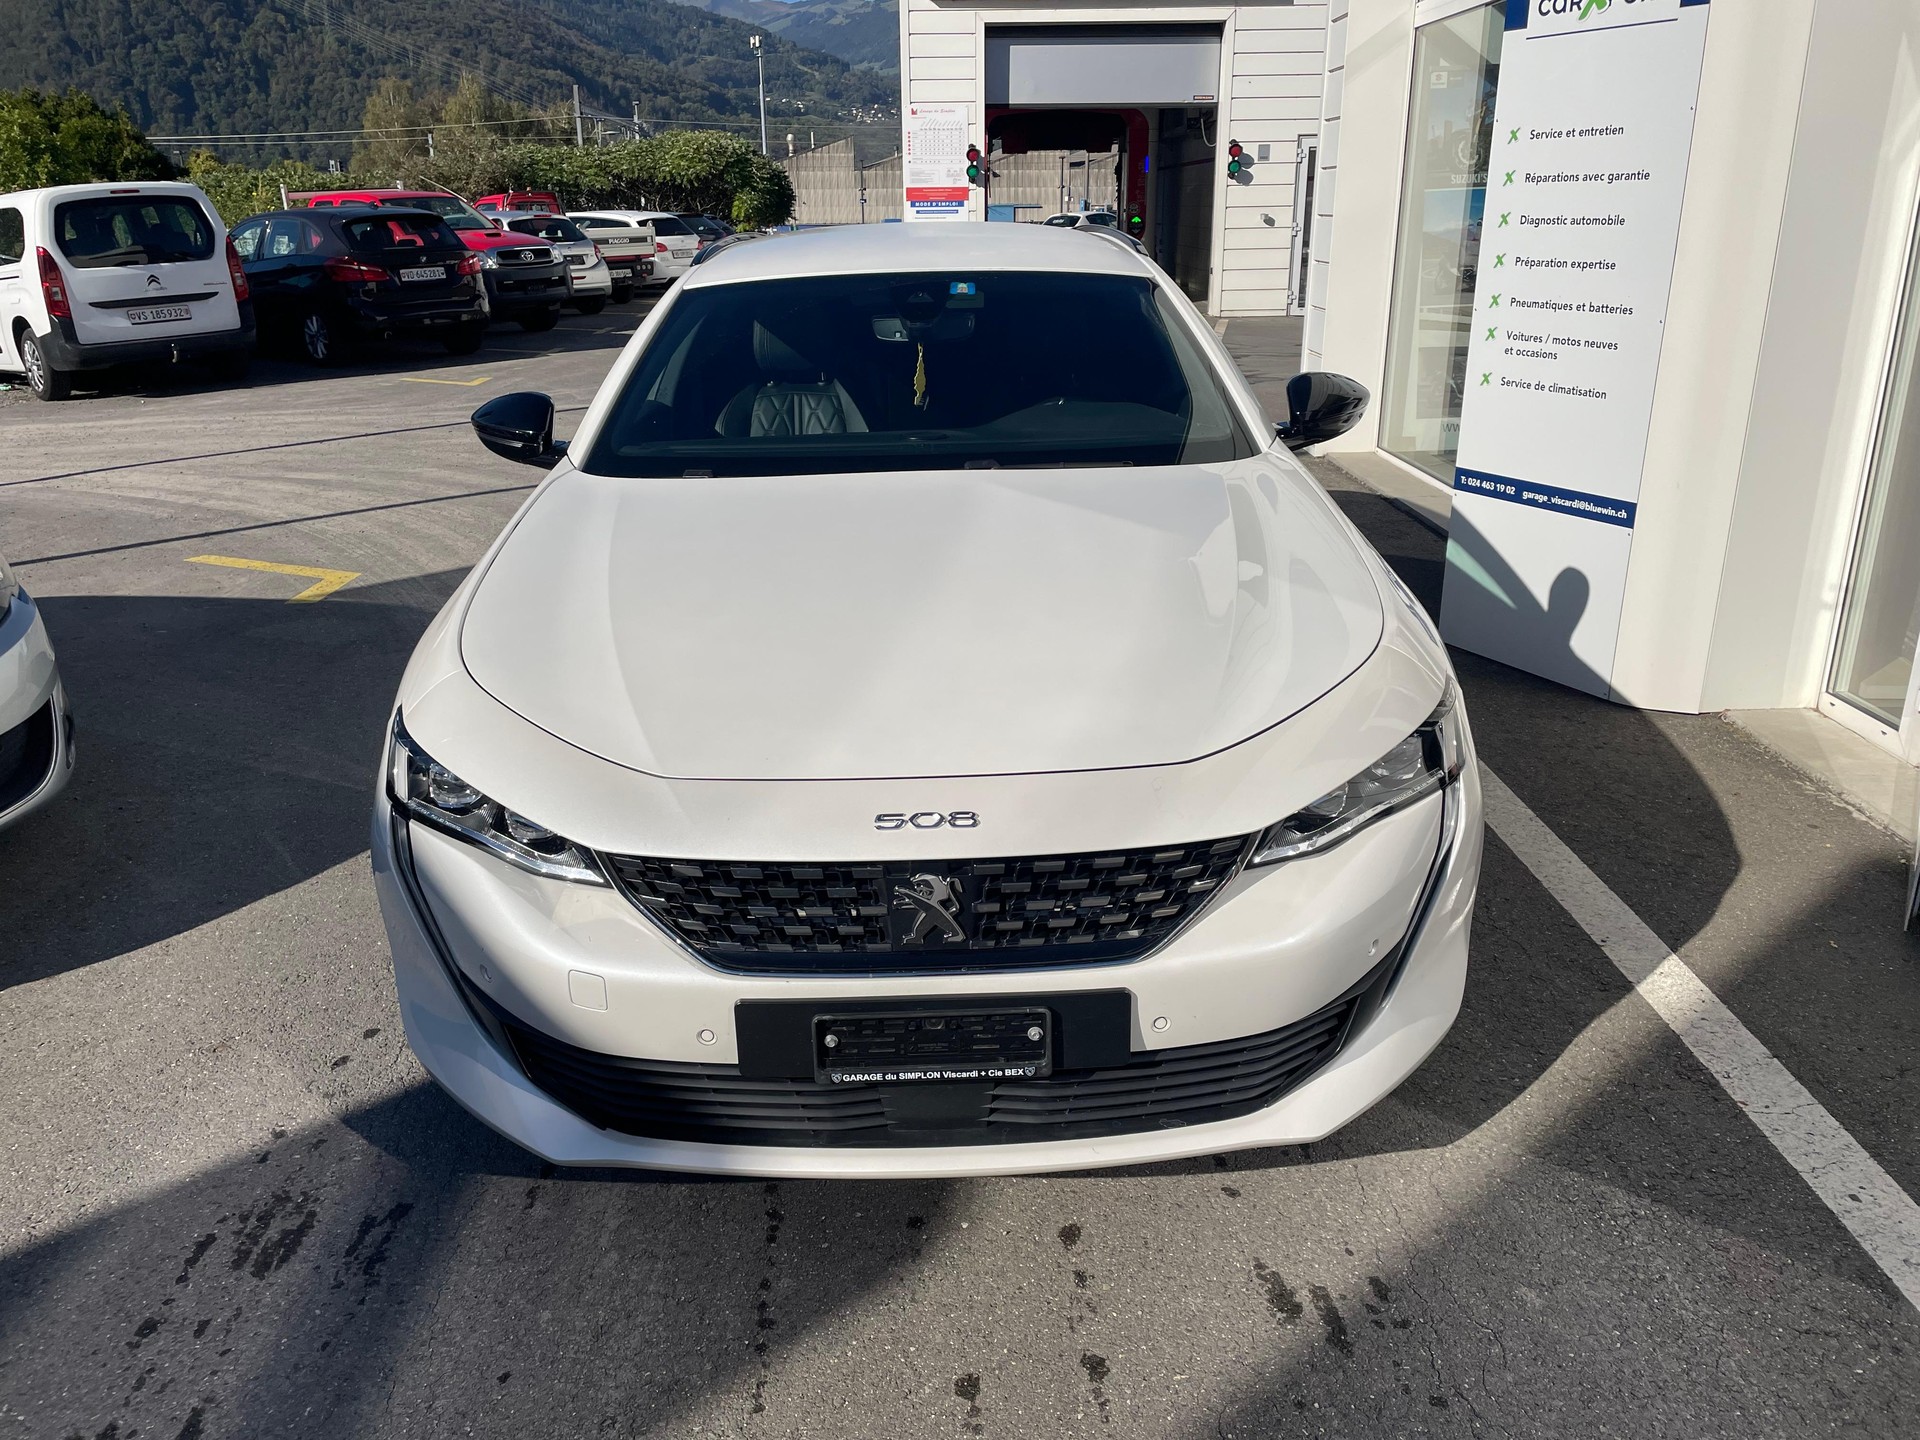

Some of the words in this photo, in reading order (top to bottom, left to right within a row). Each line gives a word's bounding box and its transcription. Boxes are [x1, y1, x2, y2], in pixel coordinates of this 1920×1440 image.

[1529, 128, 1563, 140] Service
[1565, 128, 1576, 138] et
[1578, 124, 1624, 137] entretien
[1524, 172, 1580, 186] Réparations
[1582, 172, 1605, 182] avec
[1607, 169, 1650, 184] garantie
[1520, 214, 1568, 228] Diagnostic
[1570, 214, 1626, 226] automobile
[1515, 256, 1568, 270] Préparation
[1570, 259, 1617, 272] expertise
[150, 308, 184, 320] 185932
[1510, 297, 1573, 312] Pneumatiques
[1575, 302, 1586, 312] et
[1588, 302, 1634, 315] batteries
[1506, 330, 1543, 343] Voitures
[1545, 333, 1551, 344] /
[1552, 337, 1581, 347] motos
[1583, 340, 1619, 351] neuves
[1504, 347, 1514, 355] et
[1515, 348, 1558, 360] occasions
[1500, 376, 1532, 390] Service
[1534, 381, 1546, 391] de
[1548, 383, 1607, 399] climatisation
[1460, 475, 1467, 484] T:
[1467, 477, 1481, 488] 024
[1481, 480, 1495, 491] 463
[1496, 483, 1505, 493] 19
[1505, 485, 1516, 495] 02
[1522, 490, 1628, 519] garage_viscardi@bluewin.ch
[874, 811, 980, 830] 508
[842, 1073, 883, 1082] GARAGE
[898, 1071, 941, 1080] SIMPLON
[942, 1070, 979, 1079] Viscardi
[1004, 1068, 1025, 1076] BEX
